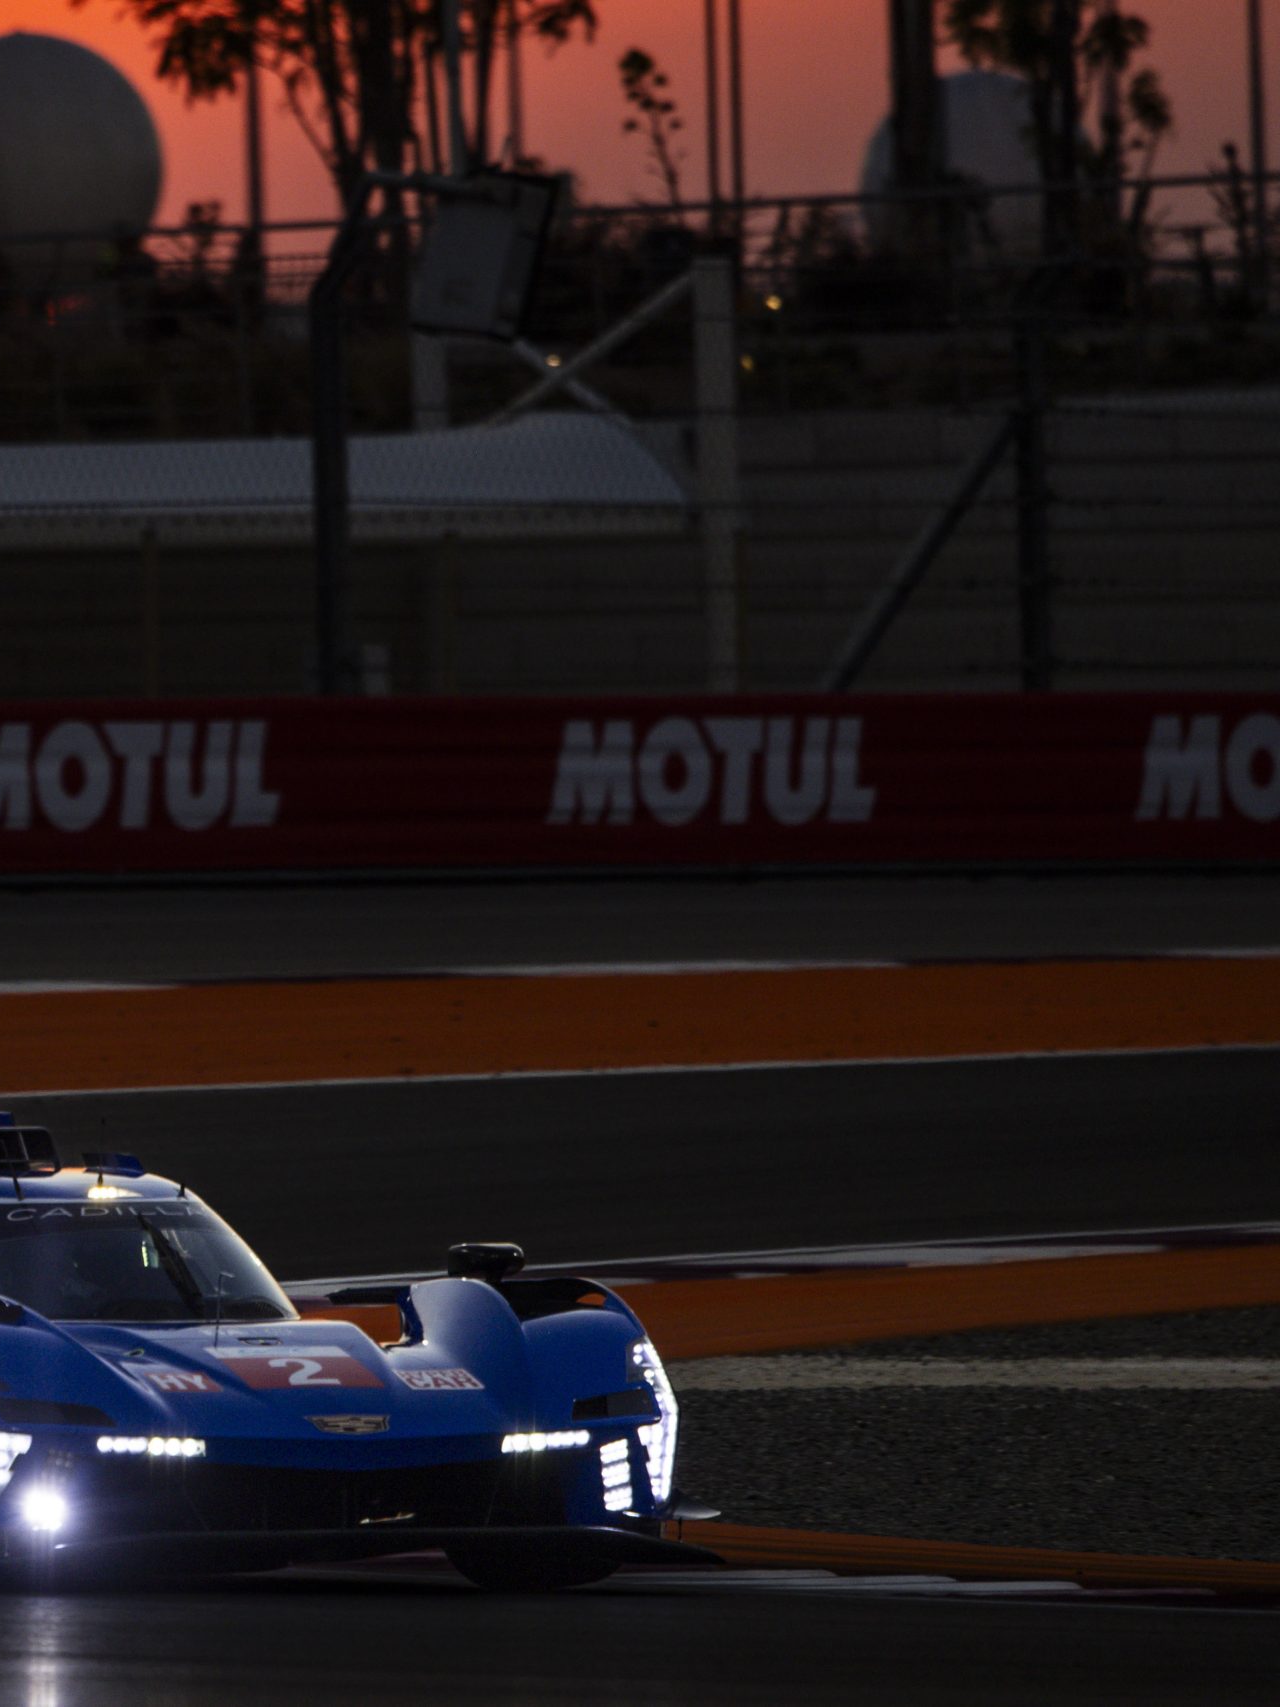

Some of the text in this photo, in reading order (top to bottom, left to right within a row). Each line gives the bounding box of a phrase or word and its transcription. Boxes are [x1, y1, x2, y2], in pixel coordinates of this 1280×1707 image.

[546, 714, 878, 826] MOTUL
[152, 1372, 210, 1390] HY
[267, 1357, 341, 1386] 2
